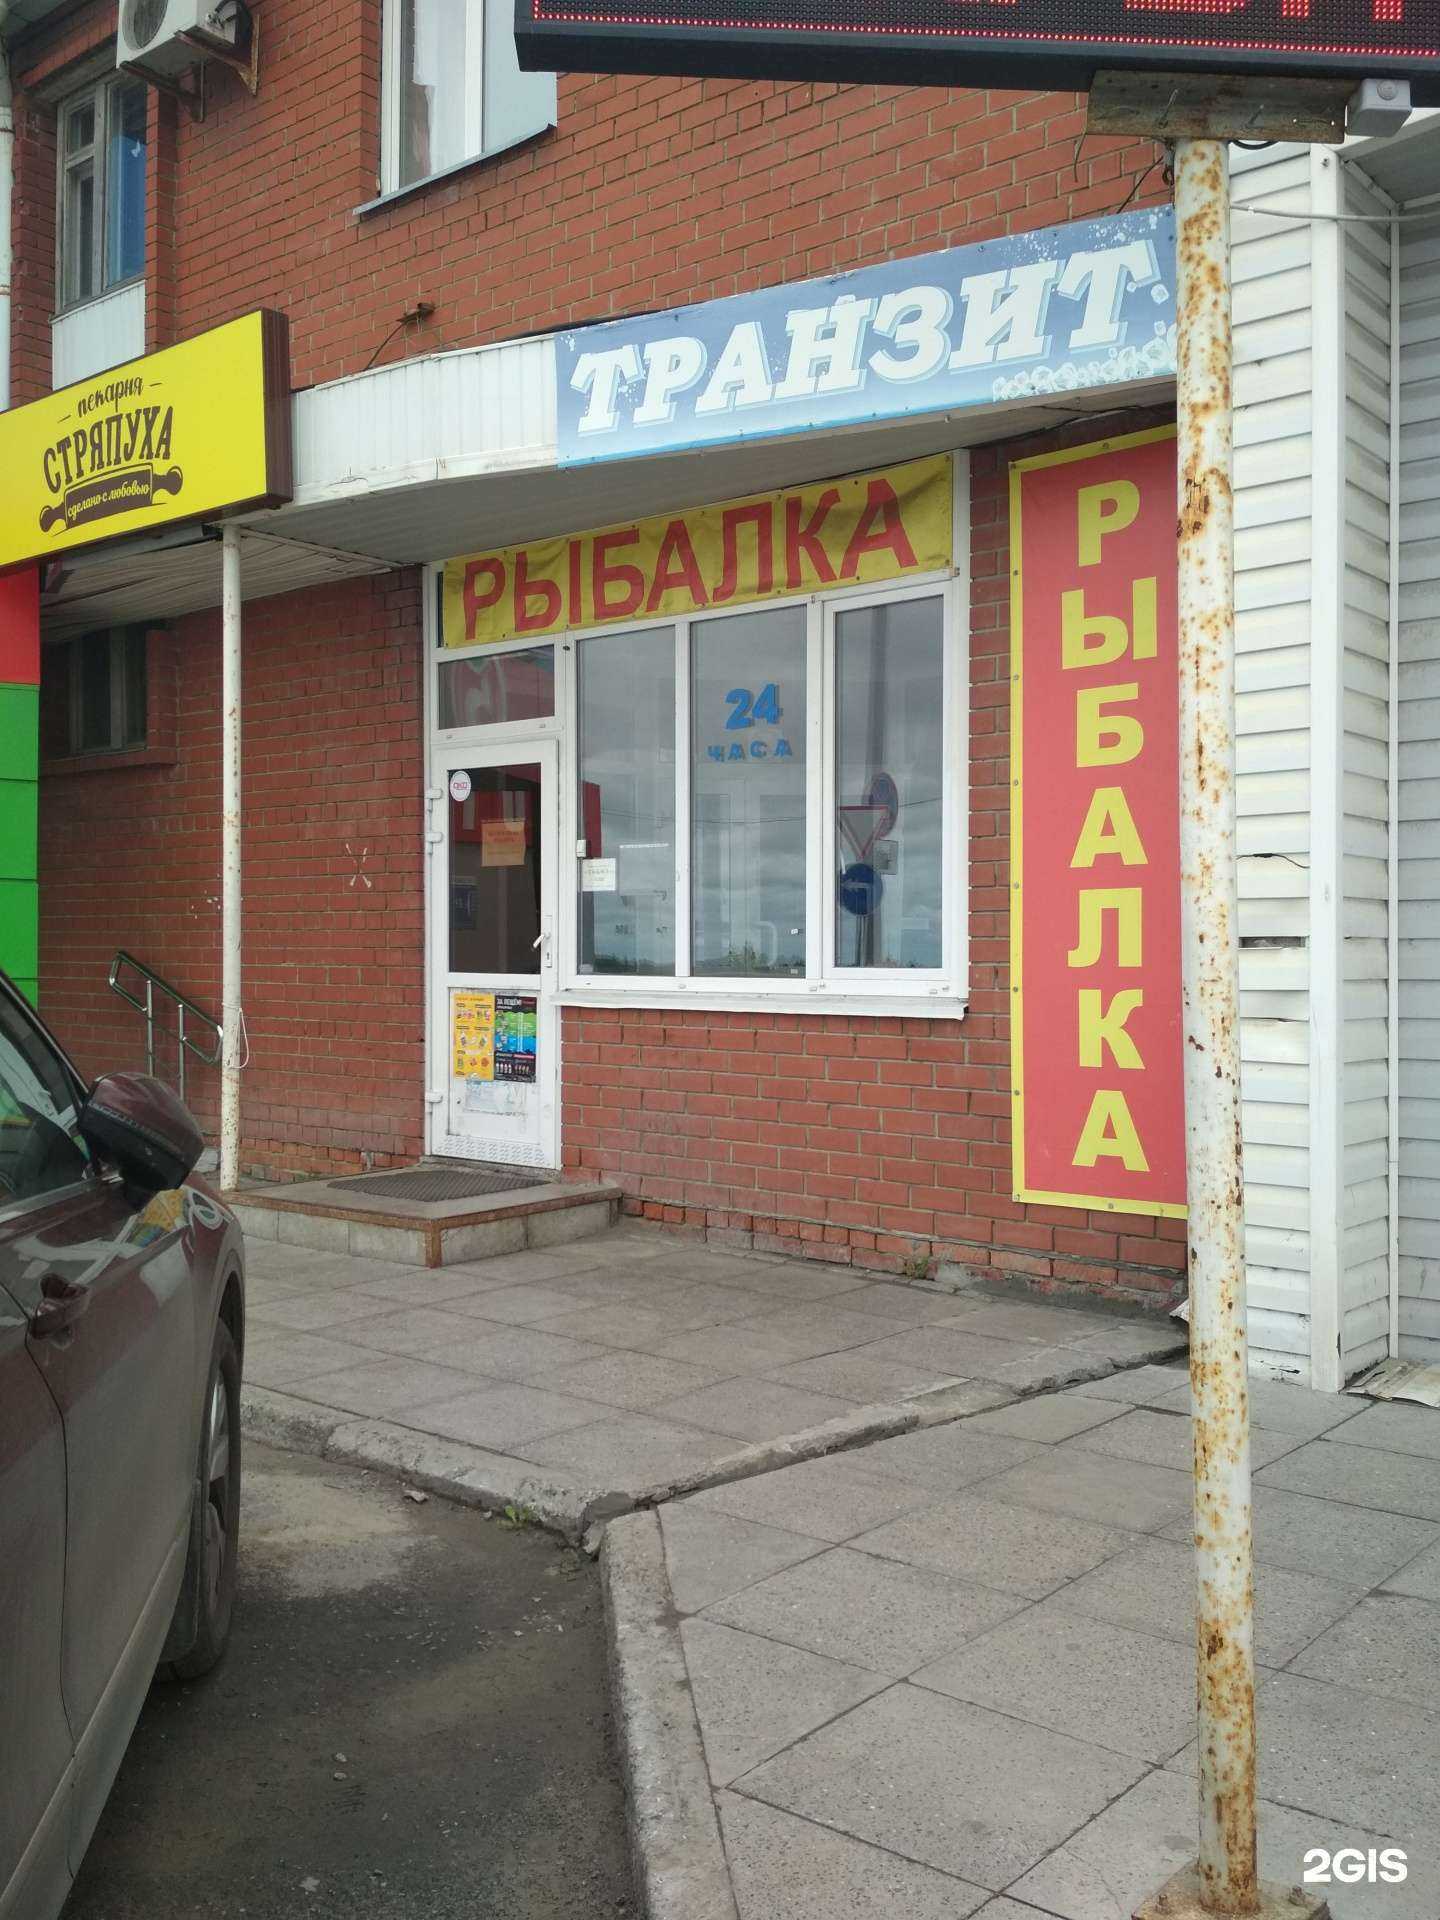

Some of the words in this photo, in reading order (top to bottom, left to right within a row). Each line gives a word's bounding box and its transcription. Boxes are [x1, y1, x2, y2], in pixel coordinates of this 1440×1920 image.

[569, 239, 1160, 438] ТРАНЗИТ
[77, 376, 144, 418] пекарня
[43, 405, 174, 494] СТРЯПУХА
[67, 494, 101, 521] сделано
[102, 492, 108, 502] с
[108, 480, 150, 501] любовью
[462, 478, 919, 641] РЫБАЛКА
[725, 683, 783, 730] 24
[707, 739, 793, 763] ЧАСА
[1060, 479, 1158, 1173] РЫБАЛКА
